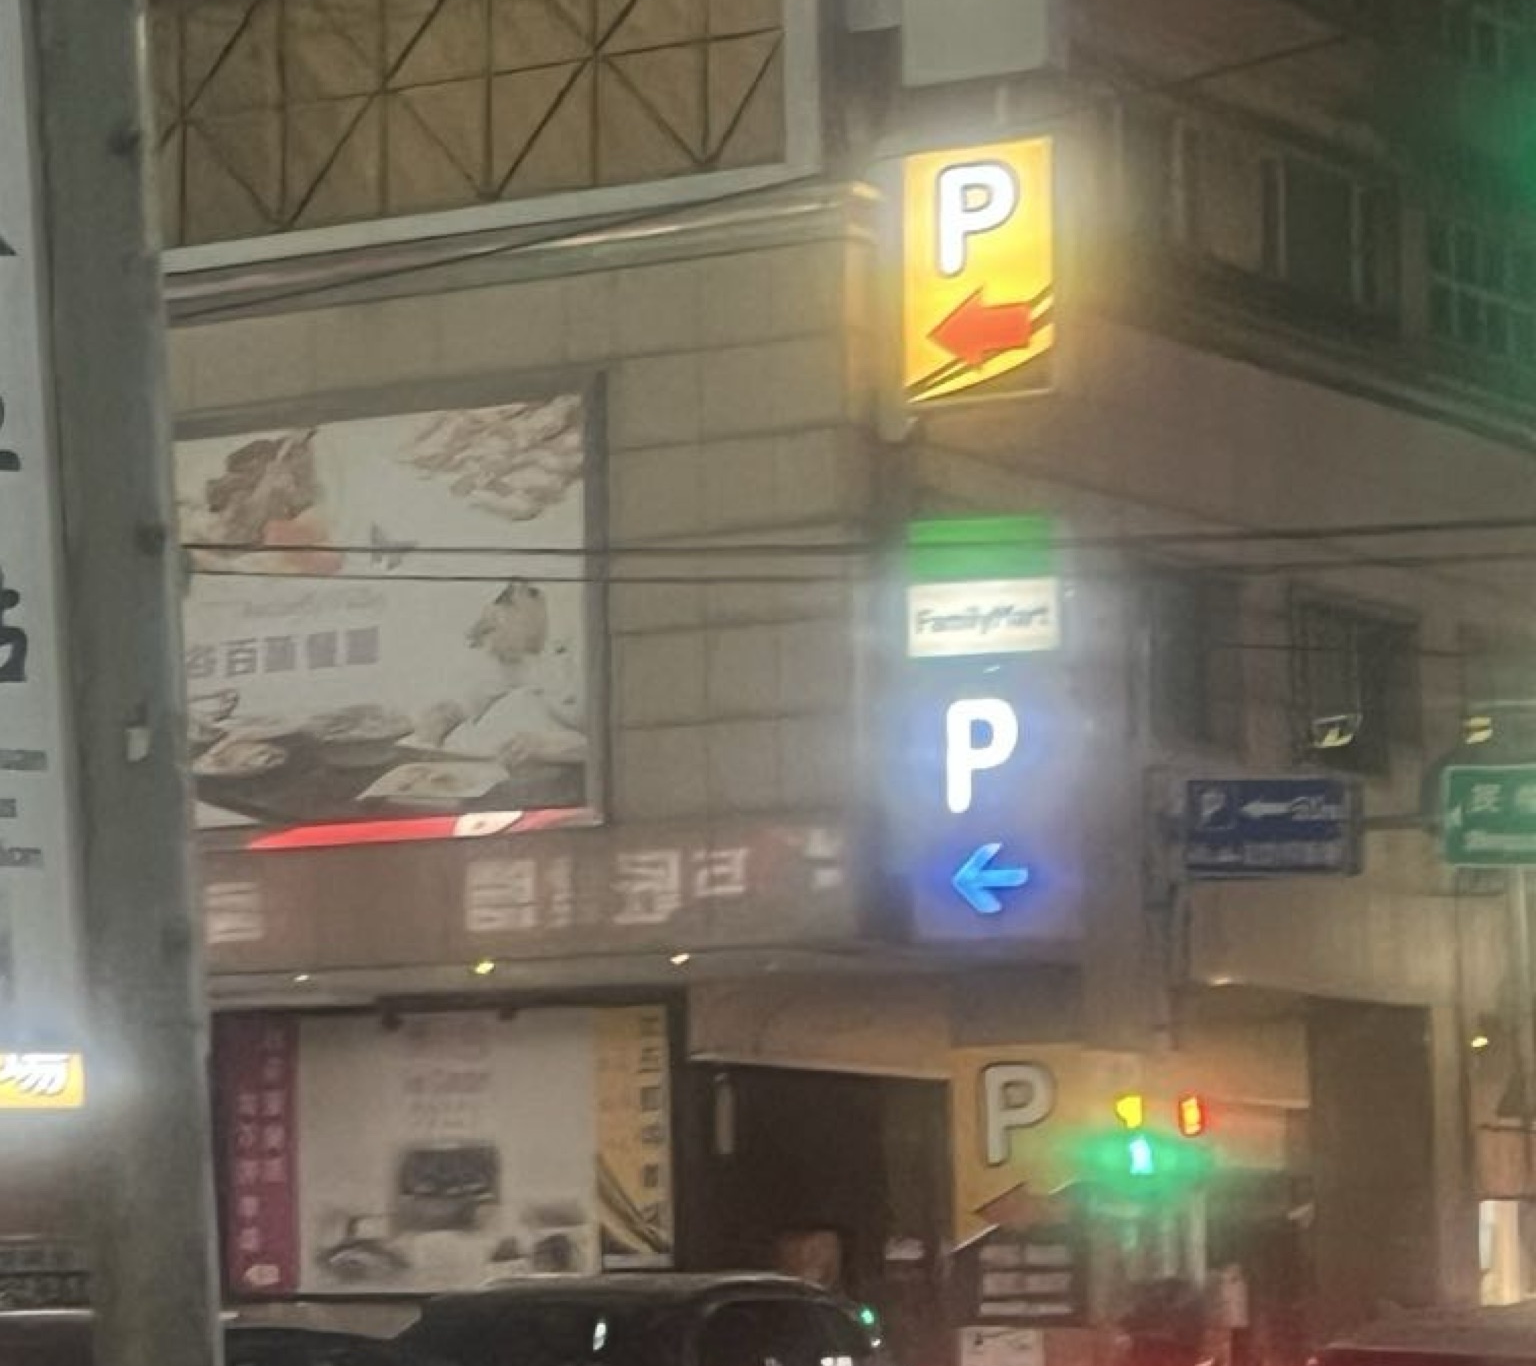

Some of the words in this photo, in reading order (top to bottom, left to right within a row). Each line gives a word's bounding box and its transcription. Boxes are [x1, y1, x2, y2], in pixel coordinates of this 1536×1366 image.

[935, 159, 1022, 279] P
[945, 697, 1020, 815] P
[982, 1062, 1057, 1167] P
